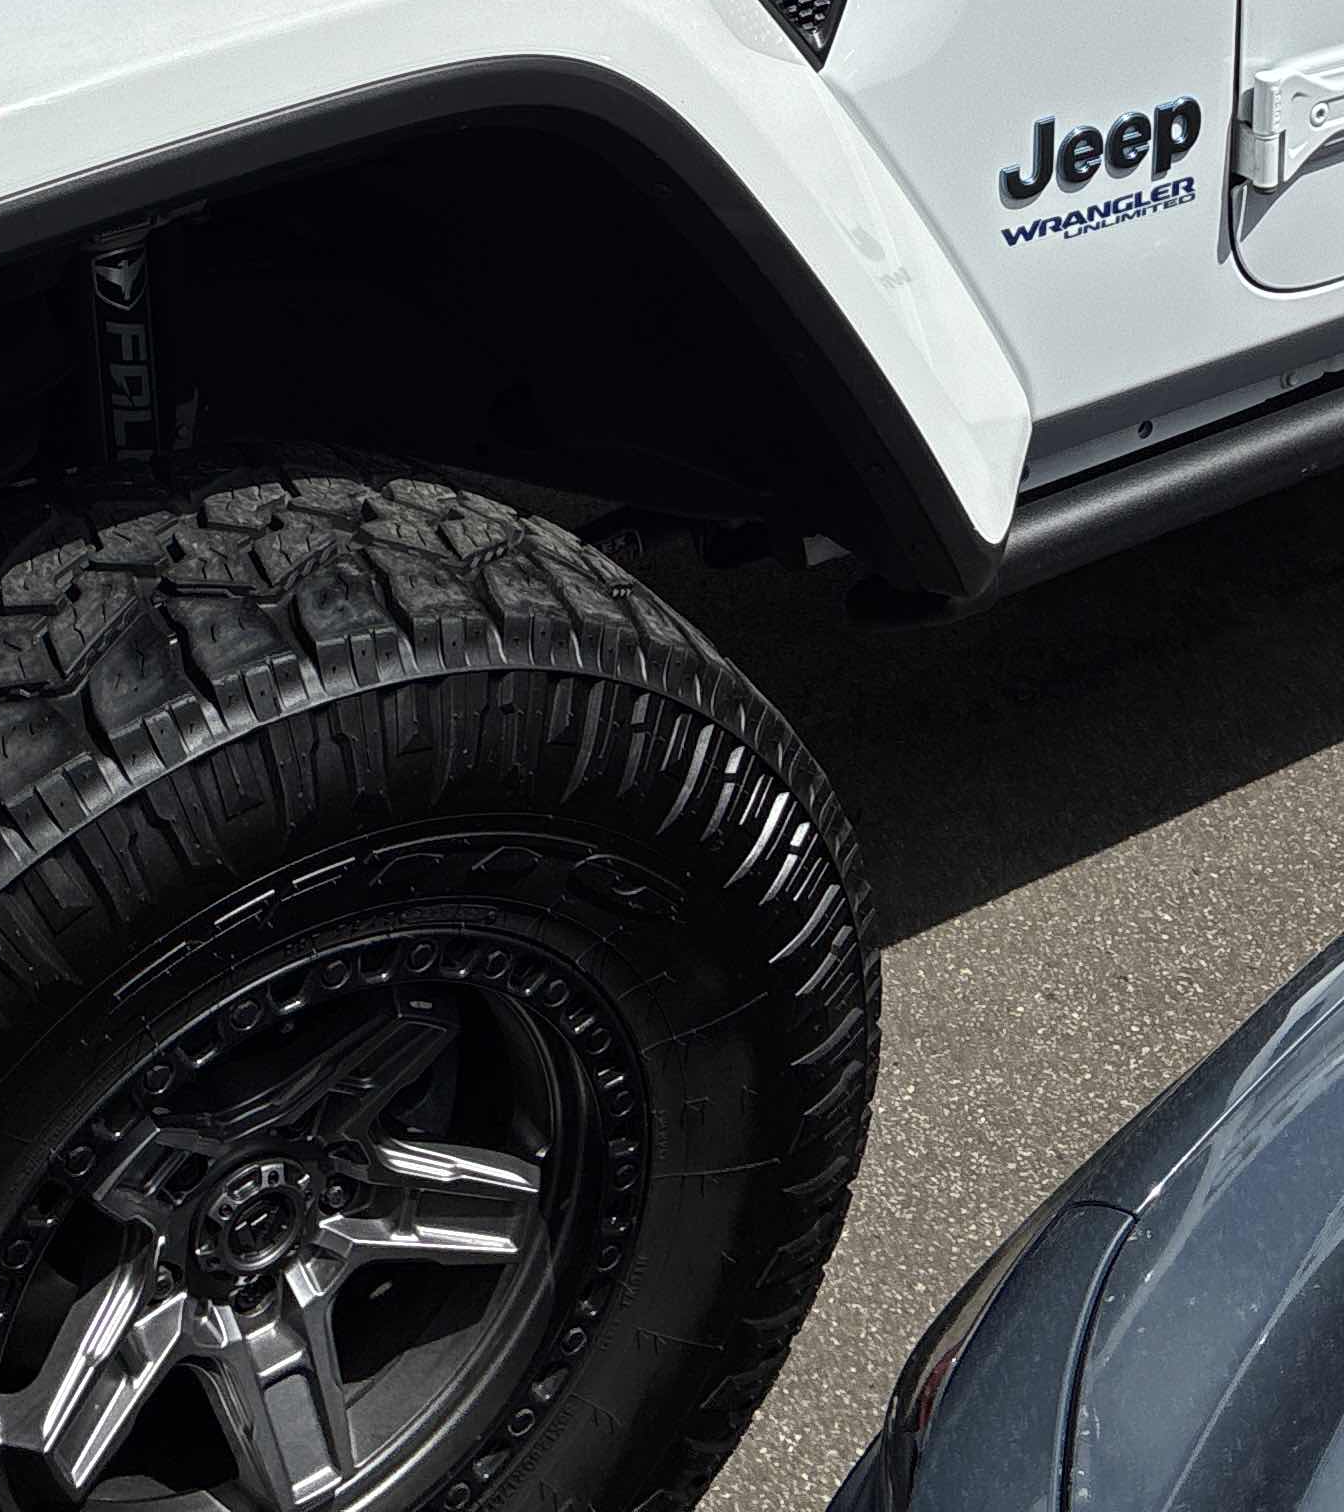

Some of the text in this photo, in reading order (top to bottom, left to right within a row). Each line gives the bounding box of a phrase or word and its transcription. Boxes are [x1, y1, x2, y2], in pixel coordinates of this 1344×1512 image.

[999, 96, 1201, 201] Jeep
[1000, 176, 1197, 247] WRANGLER
[1063, 193, 1197, 239] UNLIMITED
